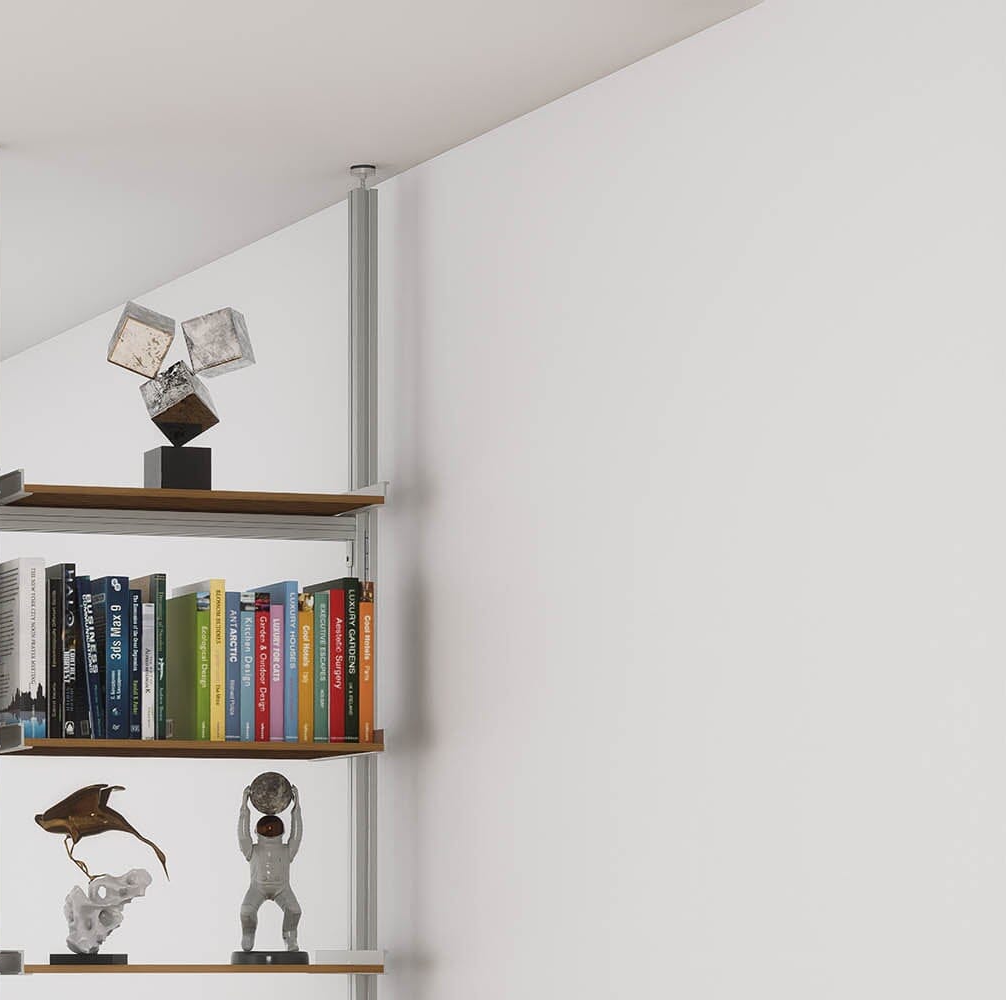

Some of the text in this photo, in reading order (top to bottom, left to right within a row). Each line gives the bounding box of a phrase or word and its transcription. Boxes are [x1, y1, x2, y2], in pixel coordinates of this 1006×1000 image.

[65, 570, 75, 627] HALO
[110, 614, 121, 637] Max
[82, 594, 94, 674] COMMUNICATIONS
[86, 594, 99, 674] BUSINESS
[110, 641, 121, 660] 3ds
[229, 609, 237, 663] ANTARCTIC
[242, 617, 252, 687] Kitchen Design
[259, 616, 267, 642] Garden
[348, 589, 356, 674] LUXURY GARDENS
[198, 626, 207, 688] Ecological Design
[259, 653, 267, 685] Outdoor
[334, 655, 342, 689] Surgery
[258, 687, 267, 712] Design
